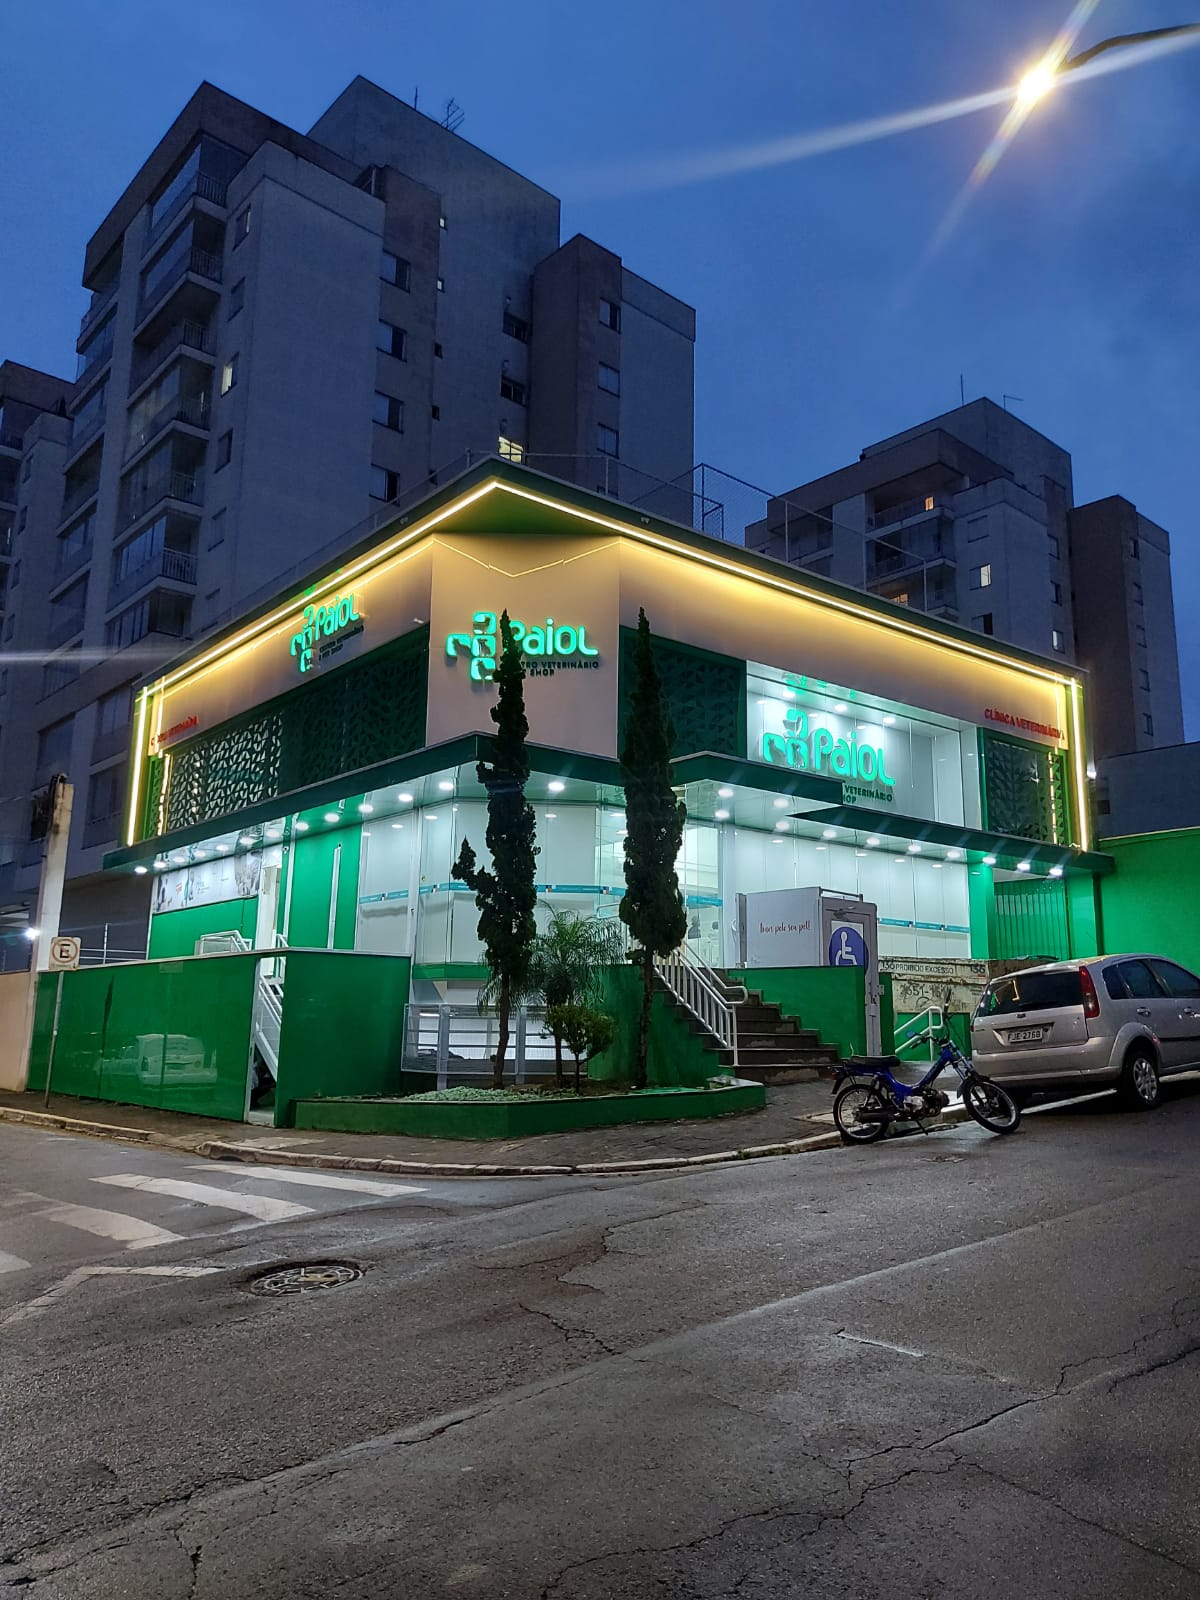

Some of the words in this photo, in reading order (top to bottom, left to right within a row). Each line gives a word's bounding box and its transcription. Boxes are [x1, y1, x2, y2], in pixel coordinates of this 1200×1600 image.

[60, 943, 71, 959] E
[895, 963, 924, 972] PROIBIDO
[925, 964, 954, 974] EXCESSO
